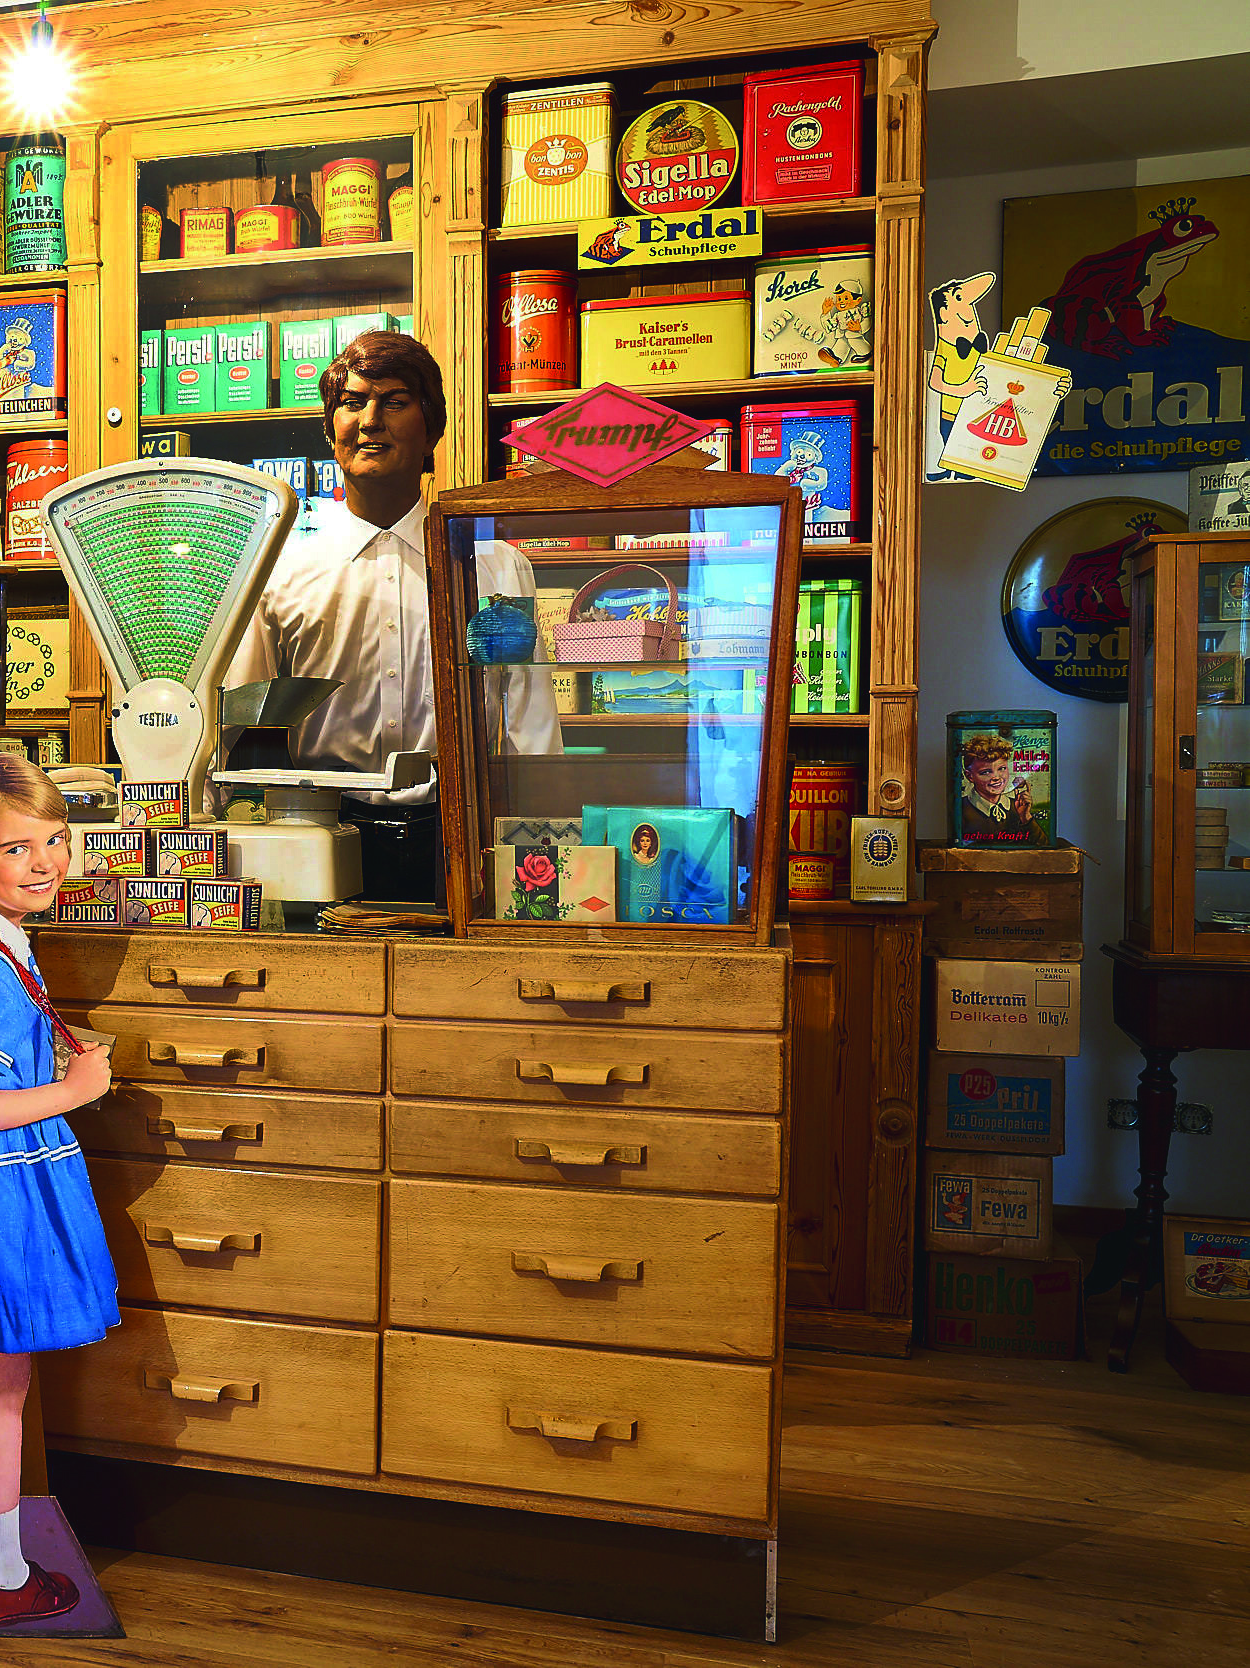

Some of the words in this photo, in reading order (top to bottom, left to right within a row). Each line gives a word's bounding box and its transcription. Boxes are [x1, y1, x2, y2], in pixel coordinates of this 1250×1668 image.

[531, 97, 584, 111] ZENTILLEN
[768, 95, 842, 118] Rachengold
[530, 154, 547, 164] bon
[566, 151, 582, 160] bon
[775, 151, 833, 163] HUSTENBONBONS
[537, 164, 575, 177] ZENTIS
[624, 154, 729, 189] Sigella
[10, 196, 53, 211] ADLER
[7, 208, 61, 225] GEWÜRZE
[636, 212, 759, 243] Erdal
[649, 241, 736, 258] Schuhpflege
[767, 269, 824, 302] Storck
[502, 293, 558, 327] Villosa
[639, 320, 689, 335] Kaiser's
[218, 330, 263, 363] Persil
[283, 326, 329, 361] Persil
[615, 332, 713, 350] Brust-Caramellen
[167, 334, 213, 367] Persil
[774, 352, 808, 362] SCHOKO
[1020, 347, 1031, 356] HB
[780, 361, 802, 370] MINT
[1047, 366, 1246, 434] rdal
[545, 408, 678, 452] Trumpf
[984, 413, 1015, 439] HB
[1049, 441, 1086, 460] die
[1089, 436, 1242, 462] Schuhpflege
[1199, 473, 1239, 490] Pfeiffer
[1036, 625, 1129, 662] Erd
[1013, 735, 1049, 748] Henze
[1013, 750, 1049, 762] Milch
[1013, 761, 1049, 773] Ecken
[124, 784, 178, 801] SUNLICHT
[148, 804, 175, 817] SEIFE
[86, 833, 140, 850] SUNLICHT
[161, 834, 212, 850] SUNLICHT
[964, 833, 994, 842] geben
[997, 831, 1029, 841] Kraft!
[110, 852, 137, 866] SEIFE
[183, 852, 208, 866] SEIFE
[795, 864, 825, 873] MAGGI
[64, 889, 91, 903] SEIFE
[127, 882, 183, 900] SUNLICHT
[193, 884, 239, 902] SUNLICHT
[60, 904, 115, 921] SUNLICHT
[152, 900, 179, 914] SEIFE
[213, 904, 235, 917] SEIFE
[251, 886, 259, 928] SUNLICHT
[974, 926, 998, 935] Erdal
[1002, 926, 1045, 936] Rotfrosch
[950, 988, 1027, 1007] Botterram
[950, 1010, 1028, 1024] Delikateß
[964, 1073, 992, 1096] P25
[997, 1084, 1039, 1113] Pril
[954, 1113, 966, 1127] 25
[970, 1114, 1045, 1131] Doppelpakete
[940, 1179, 971, 1194] Fewa
[981, 1200, 1028, 1220] Fewa
[1191, 1233, 1204, 1242] Dr.
[935, 1262, 1035, 1316] Henko
[1016, 1319, 1037, 1335] 25
[980, 1336, 1068, 1354] DOPPELPAKETE
